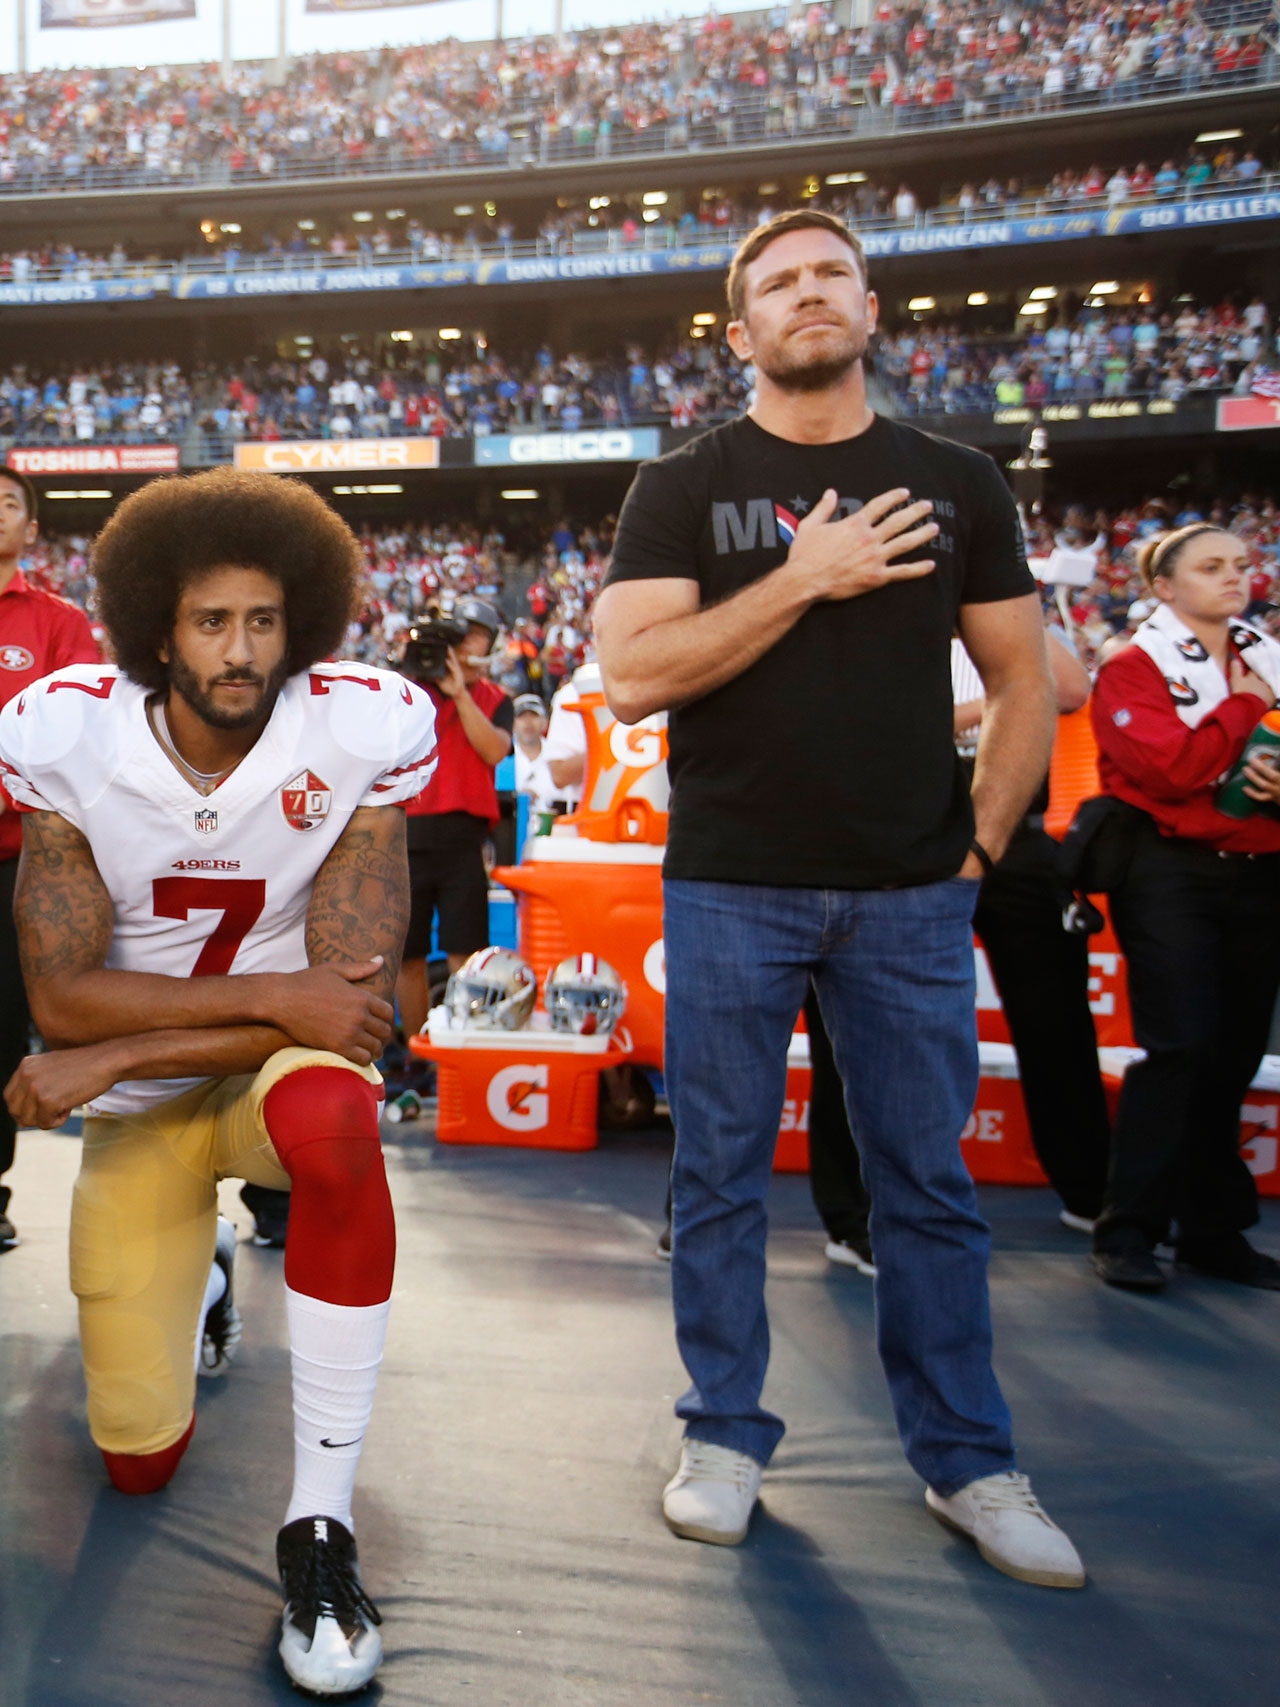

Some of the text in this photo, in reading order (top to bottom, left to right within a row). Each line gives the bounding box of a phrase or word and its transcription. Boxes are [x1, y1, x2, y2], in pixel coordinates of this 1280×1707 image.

[1140, 208, 1177, 228] 80
[899, 226, 1009, 252] DUNCAN
[506, 260, 558, 281] DON
[559, 253, 654, 277] CORYELL
[32, 284, 98, 301] FOUTS
[234, 274, 321, 294] CHARLIE
[263, 441, 409, 469] CYMER
[508, 431, 635, 463] GEICO
[11, 450, 119, 472] TOSHIBA
[609, 710, 661, 768] G
[288, 792, 324, 812] 70
[196, 818, 217, 832] NFL
[171, 859, 241, 872] 49ERS
[152, 876, 266, 978] 7
[487, 1064, 549, 1131] G
